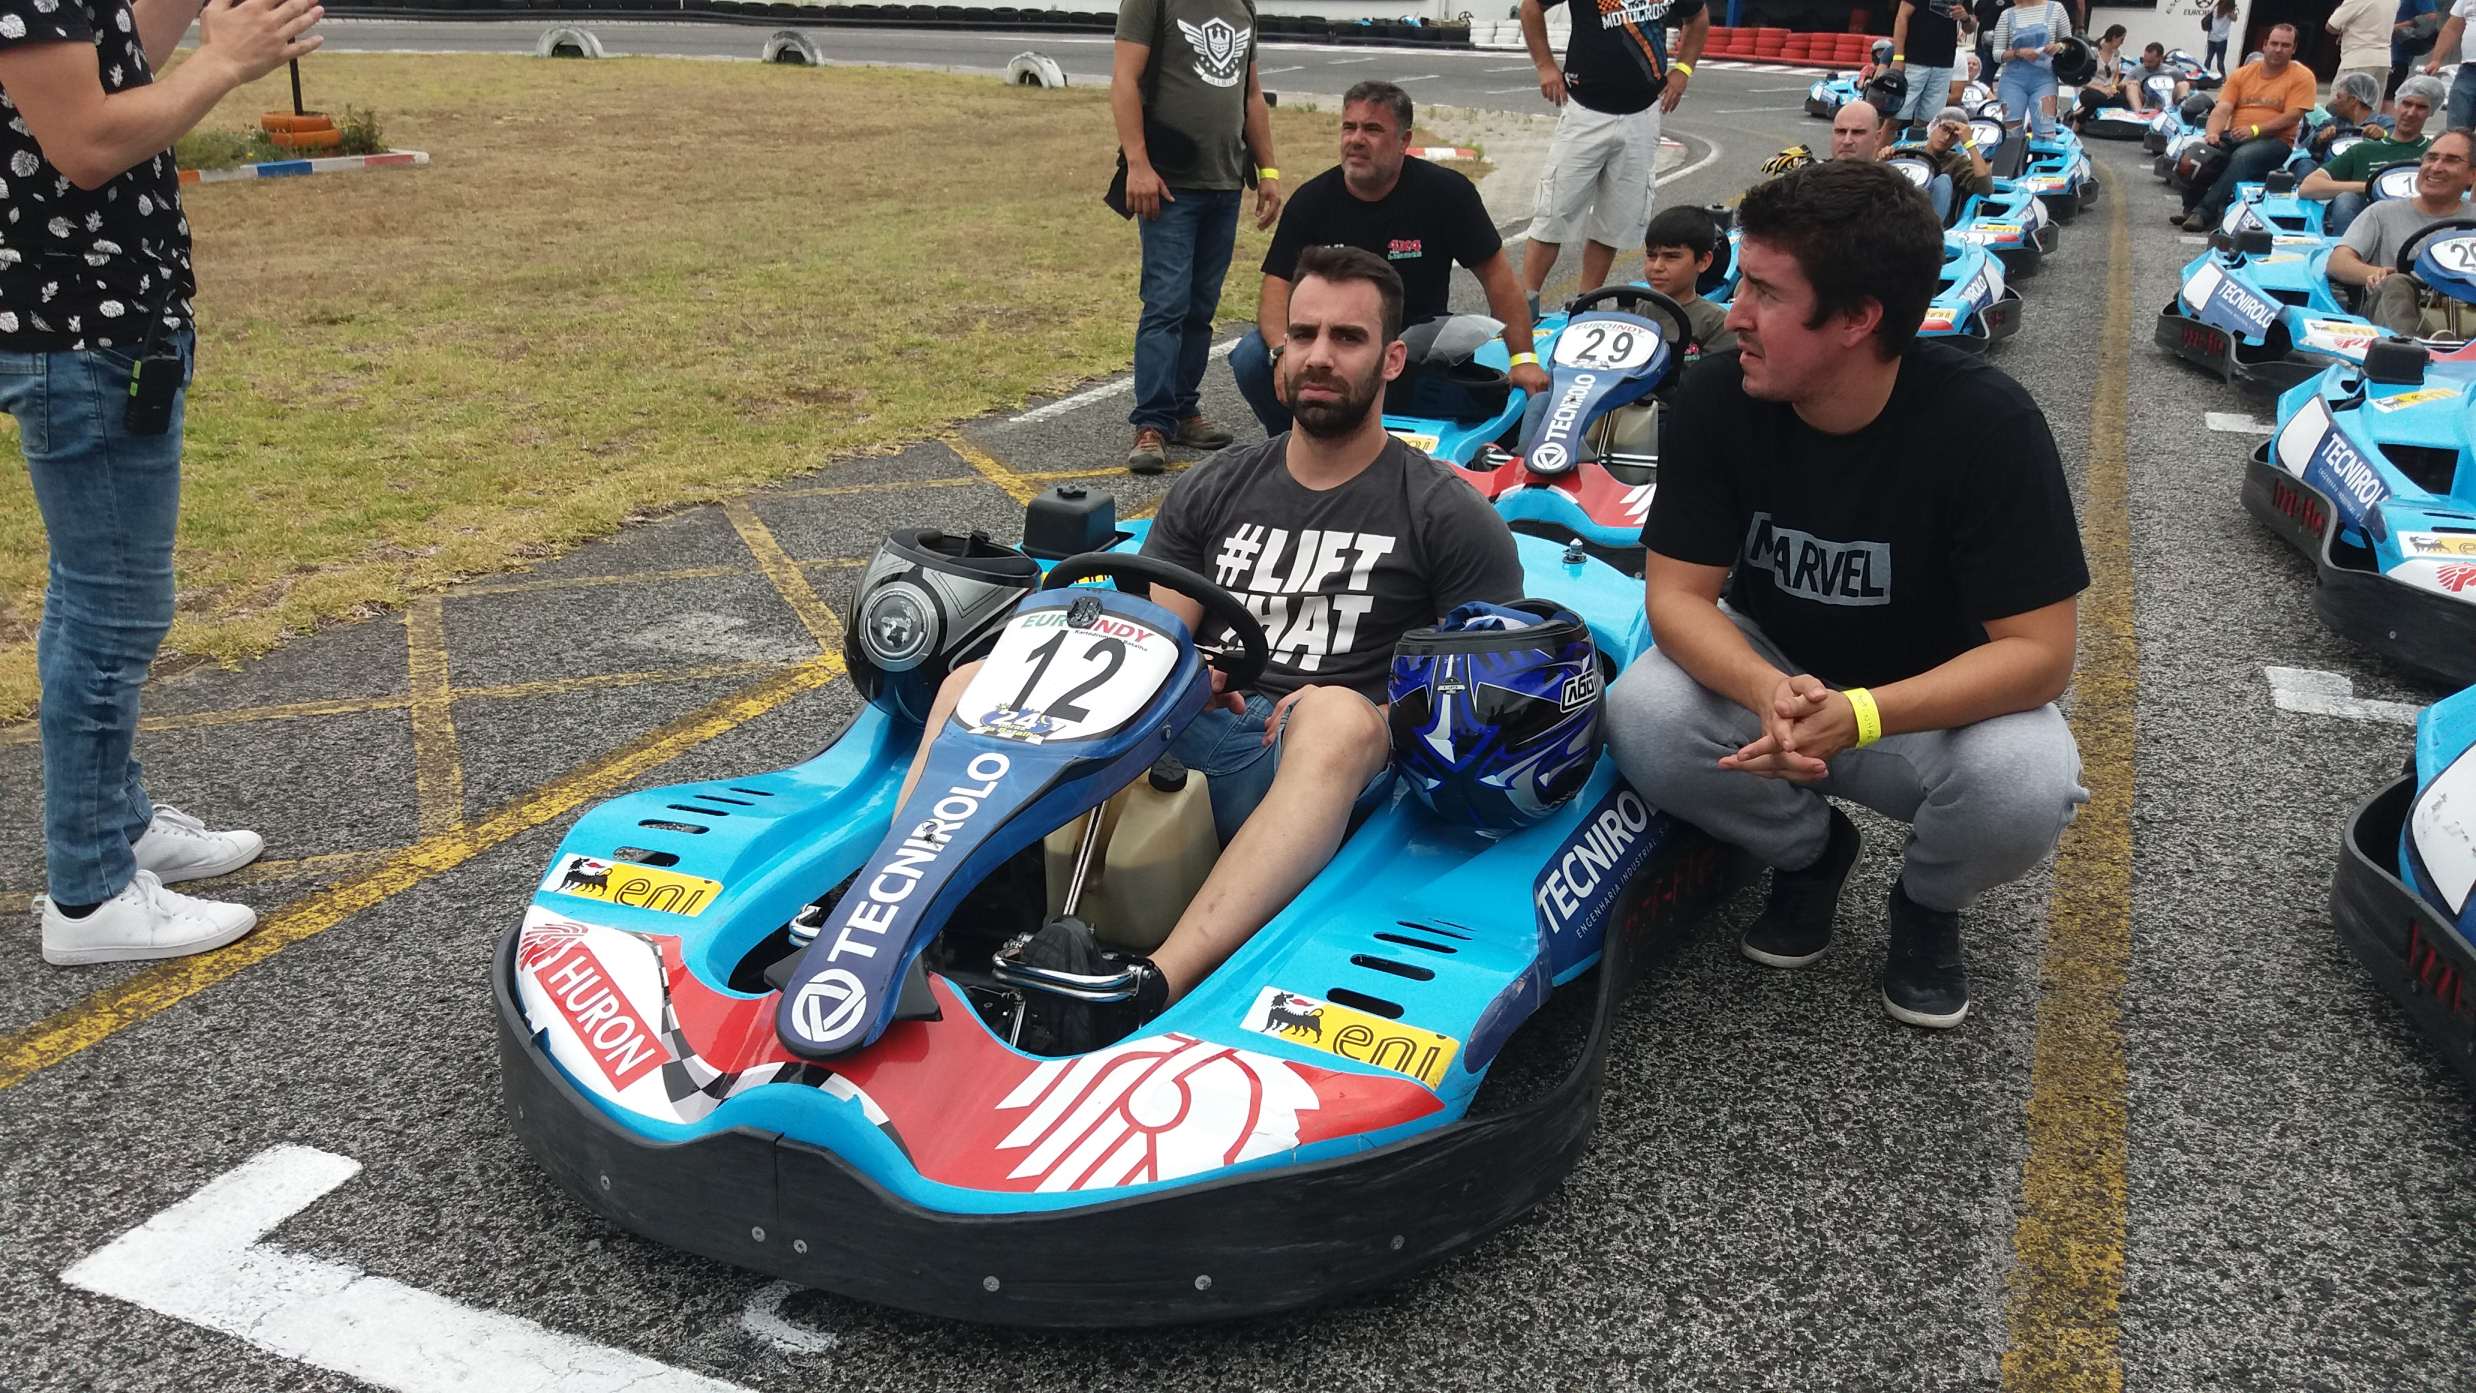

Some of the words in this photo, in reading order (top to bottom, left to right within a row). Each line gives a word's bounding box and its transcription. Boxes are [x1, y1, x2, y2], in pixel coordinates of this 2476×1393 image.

[2218, 279, 2276, 329] TECNIROLO
[1575, 328, 1634, 363] 29
[2321, 432, 2389, 510] TECNIROL
[1215, 523, 1396, 594] #LIFT
[1751, 519, 1885, 598] MARVEL
[1021, 613, 1156, 643] EURNDY
[1008, 629, 1127, 723] 12
[827, 752, 1011, 962] TECNIROLO
[1535, 790, 1658, 934] TECNIRO
[614, 878, 712, 916] eni
[1576, 883, 1621, 939] ENGENHARIA
[548, 955, 656, 1077] HURON
[1332, 1024, 1447, 1082] eni
